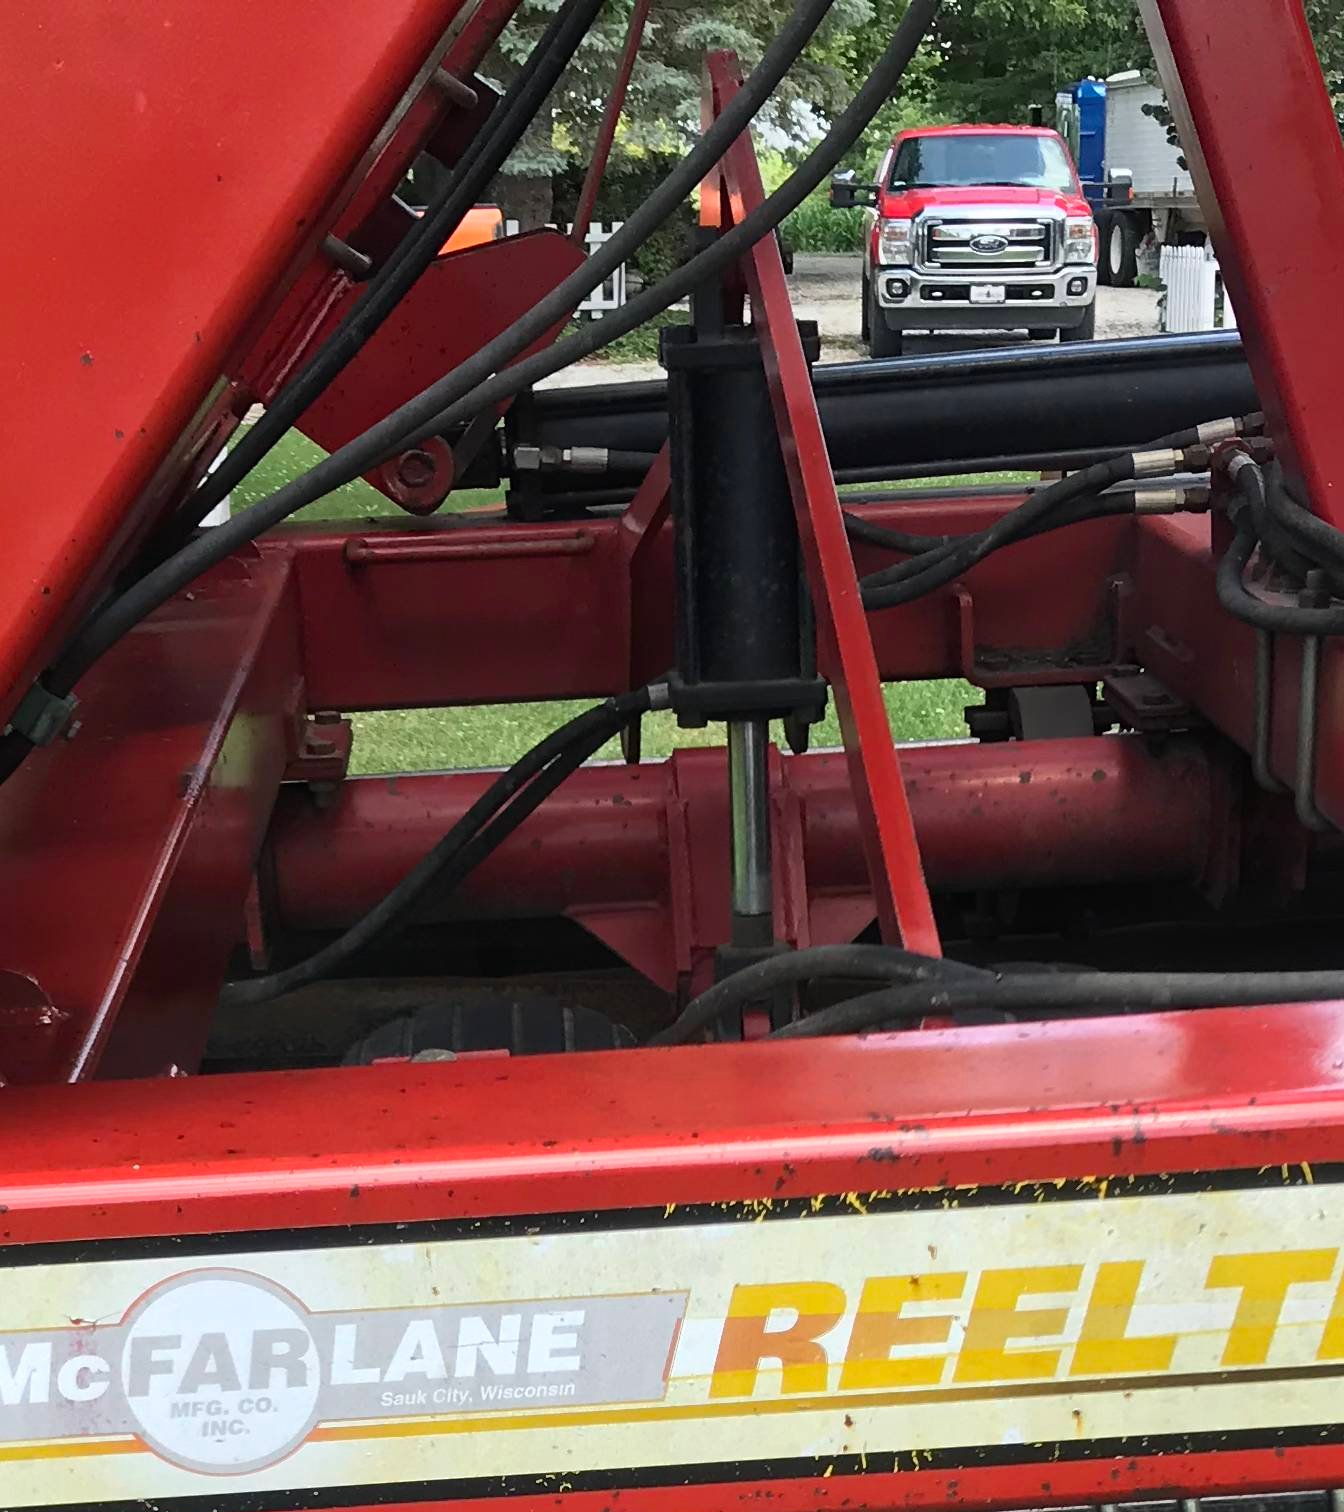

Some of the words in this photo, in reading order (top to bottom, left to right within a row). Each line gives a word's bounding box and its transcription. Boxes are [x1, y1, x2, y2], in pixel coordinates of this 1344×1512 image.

[380, 1389, 428, 1407] Sauk
[432, 1386, 473, 1404] City,
[480, 1382, 576, 1401] Wisconsin
[170, 1400, 230, 1419] MFG.
[237, 1396, 279, 1414] CO.
[201, 1419, 251, 1437] INC.
